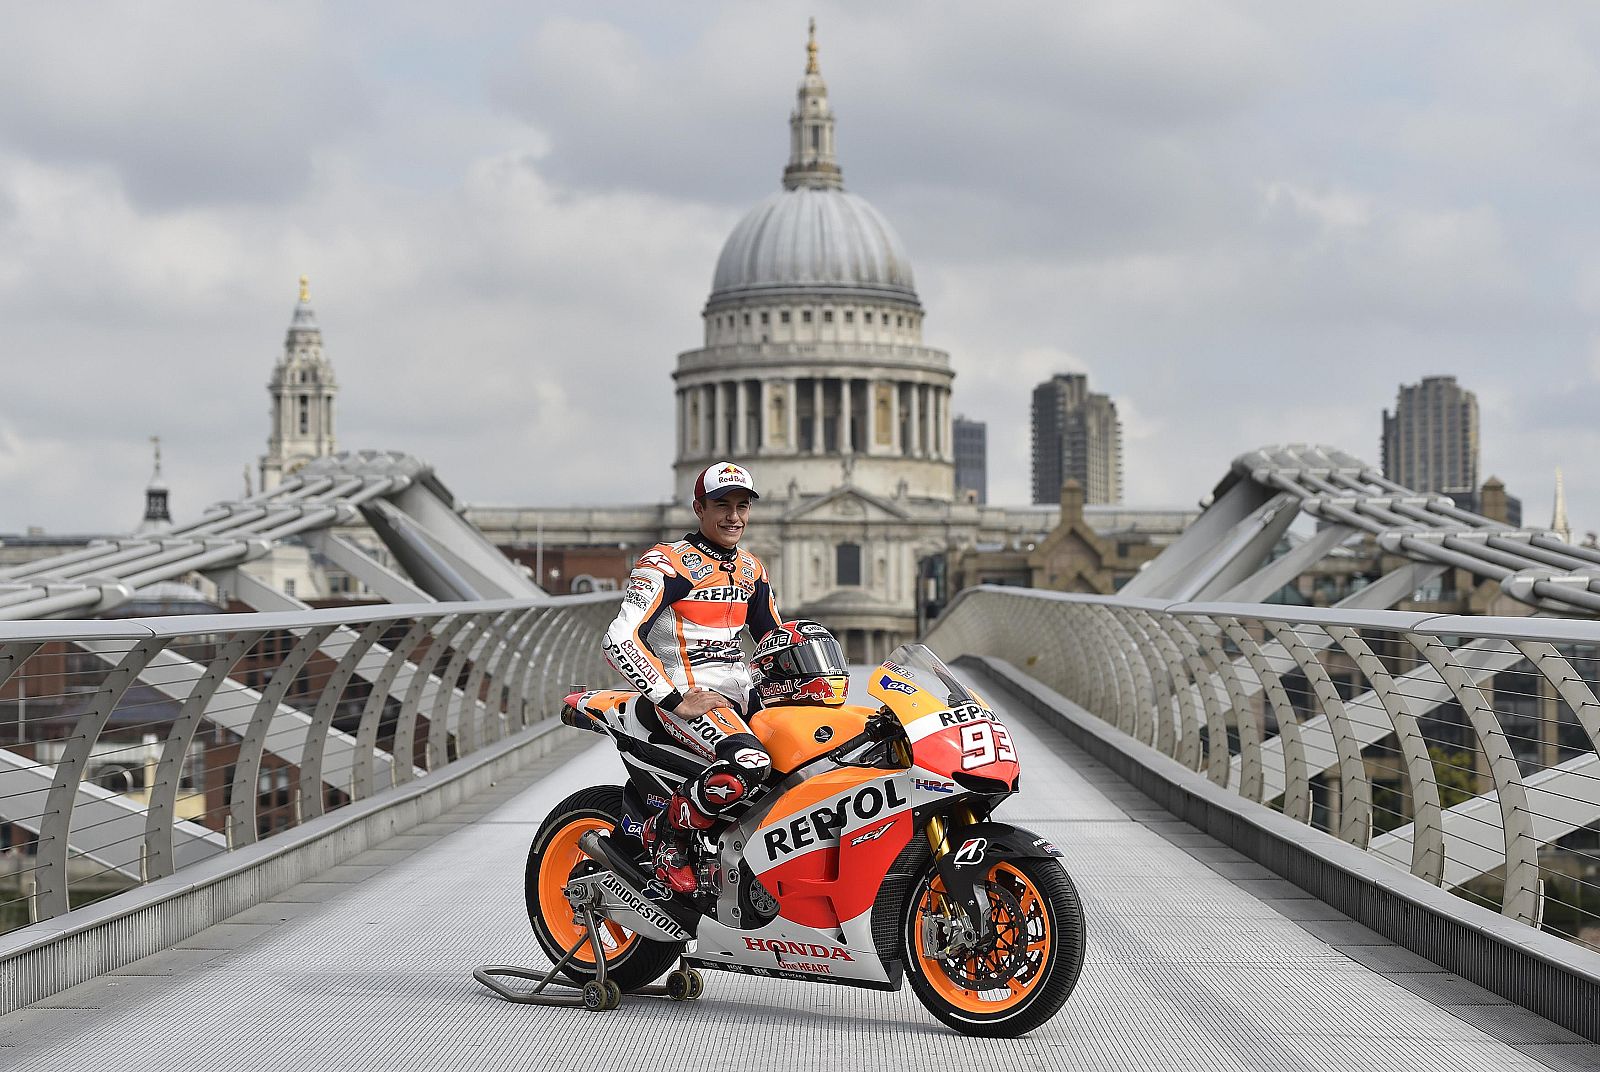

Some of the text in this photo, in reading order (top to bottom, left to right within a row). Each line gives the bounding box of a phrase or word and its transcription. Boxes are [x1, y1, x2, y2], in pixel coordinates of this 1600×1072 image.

[718, 475, 734, 484] Red
[697, 542, 723, 561] REPSOL
[610, 644, 653, 697] REPSOL
[776, 680, 794, 694] Bull
[887, 682, 914, 694] GAS
[687, 715, 724, 746] PSOL
[960, 721, 1017, 771] 93
[915, 778, 955, 793] HRC
[763, 779, 907, 862] REPSOL
[602, 872, 684, 940] BRIDGESTONE
[742, 936, 855, 962] HONDA
[778, 961, 798, 970] One
